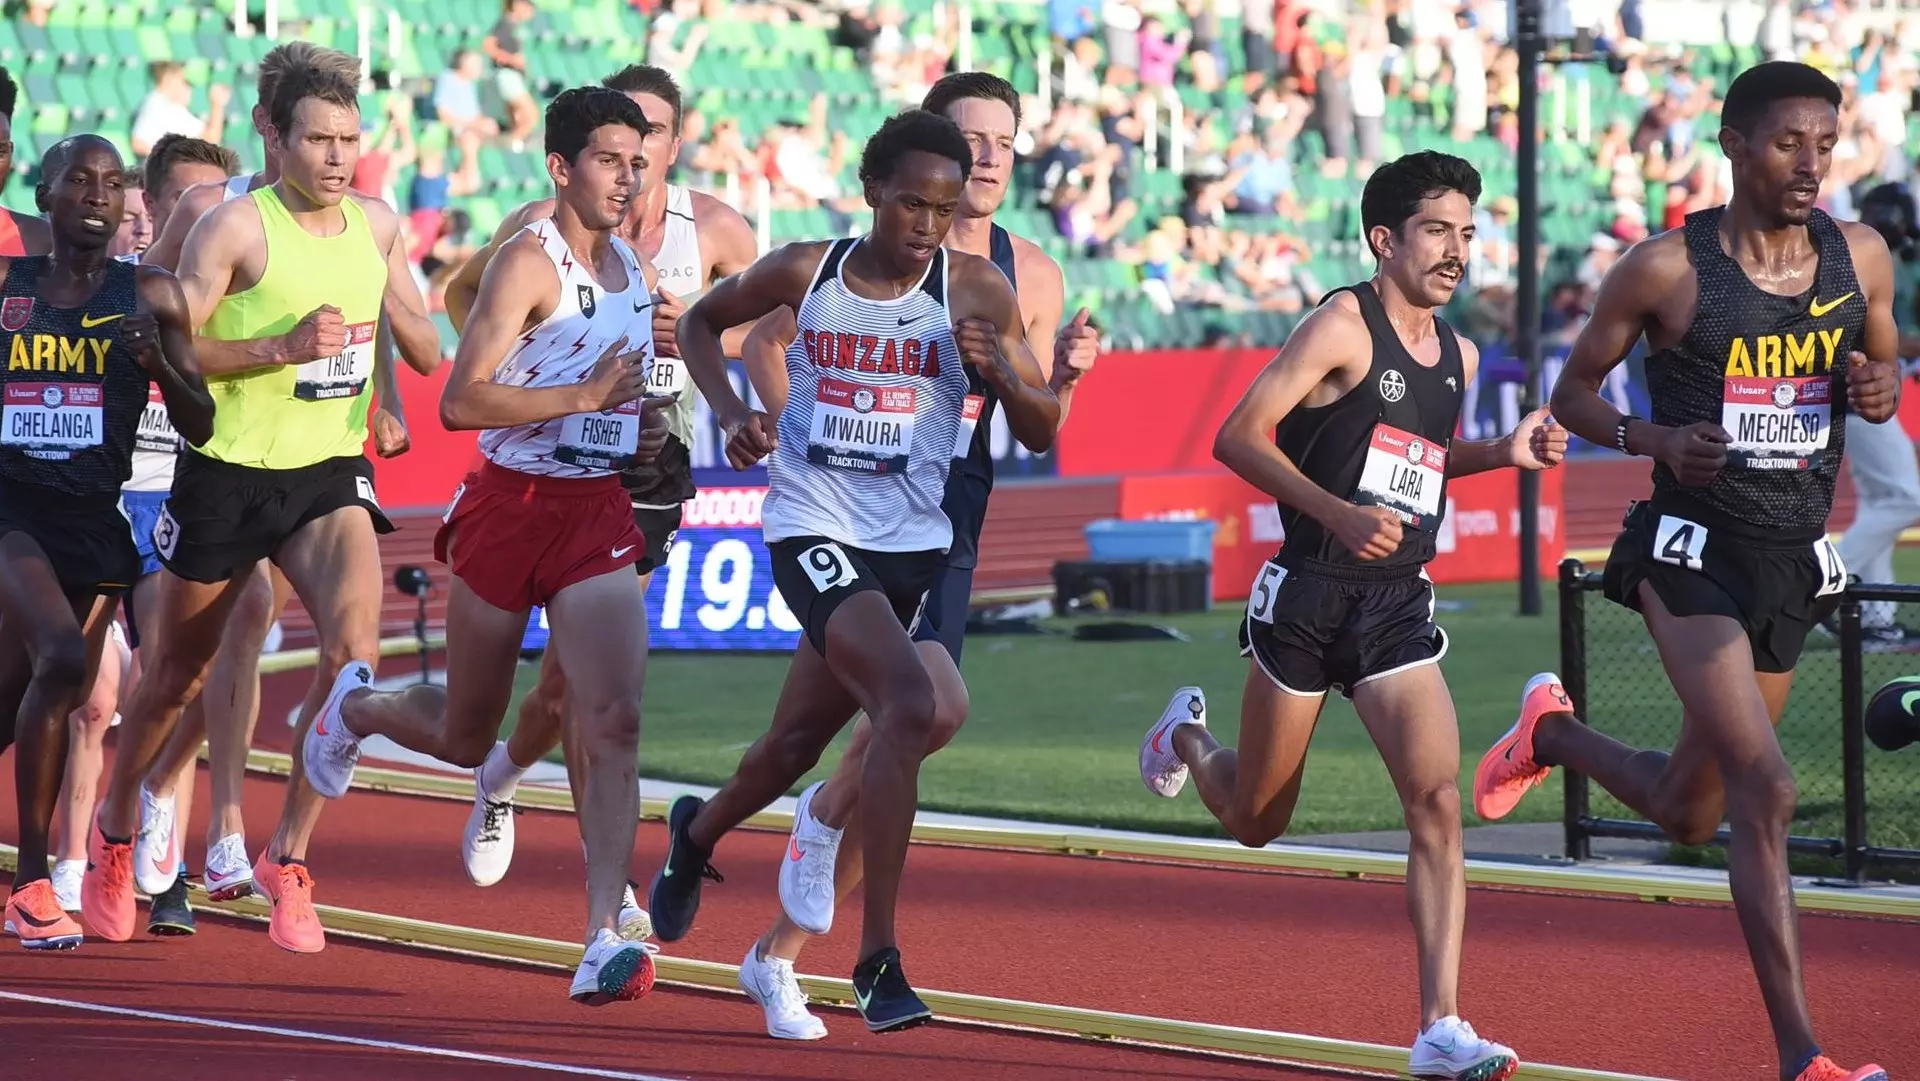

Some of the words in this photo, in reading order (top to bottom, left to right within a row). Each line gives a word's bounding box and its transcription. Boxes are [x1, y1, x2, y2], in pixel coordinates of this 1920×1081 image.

[658, 266, 694, 279] OAC
[8, 333, 113, 375] ARMY
[327, 351, 356, 377] TRUE
[804, 329, 940, 378] GONZAGA
[1725, 328, 1844, 377] ARMY
[12, 412, 94, 439] CHELANGA
[580, 416, 623, 447] FISHER
[822, 413, 901, 447] MWAURA
[1738, 412, 1820, 443] MECHESO
[1388, 463, 1424, 501] LARA
[1745, 456, 1809, 470] TRACKTOWN20
[1662, 523, 1695, 569] 4
[809, 546, 843, 585] 9
[1823, 540, 1843, 592] 4
[1253, 565, 1280, 618] 5
